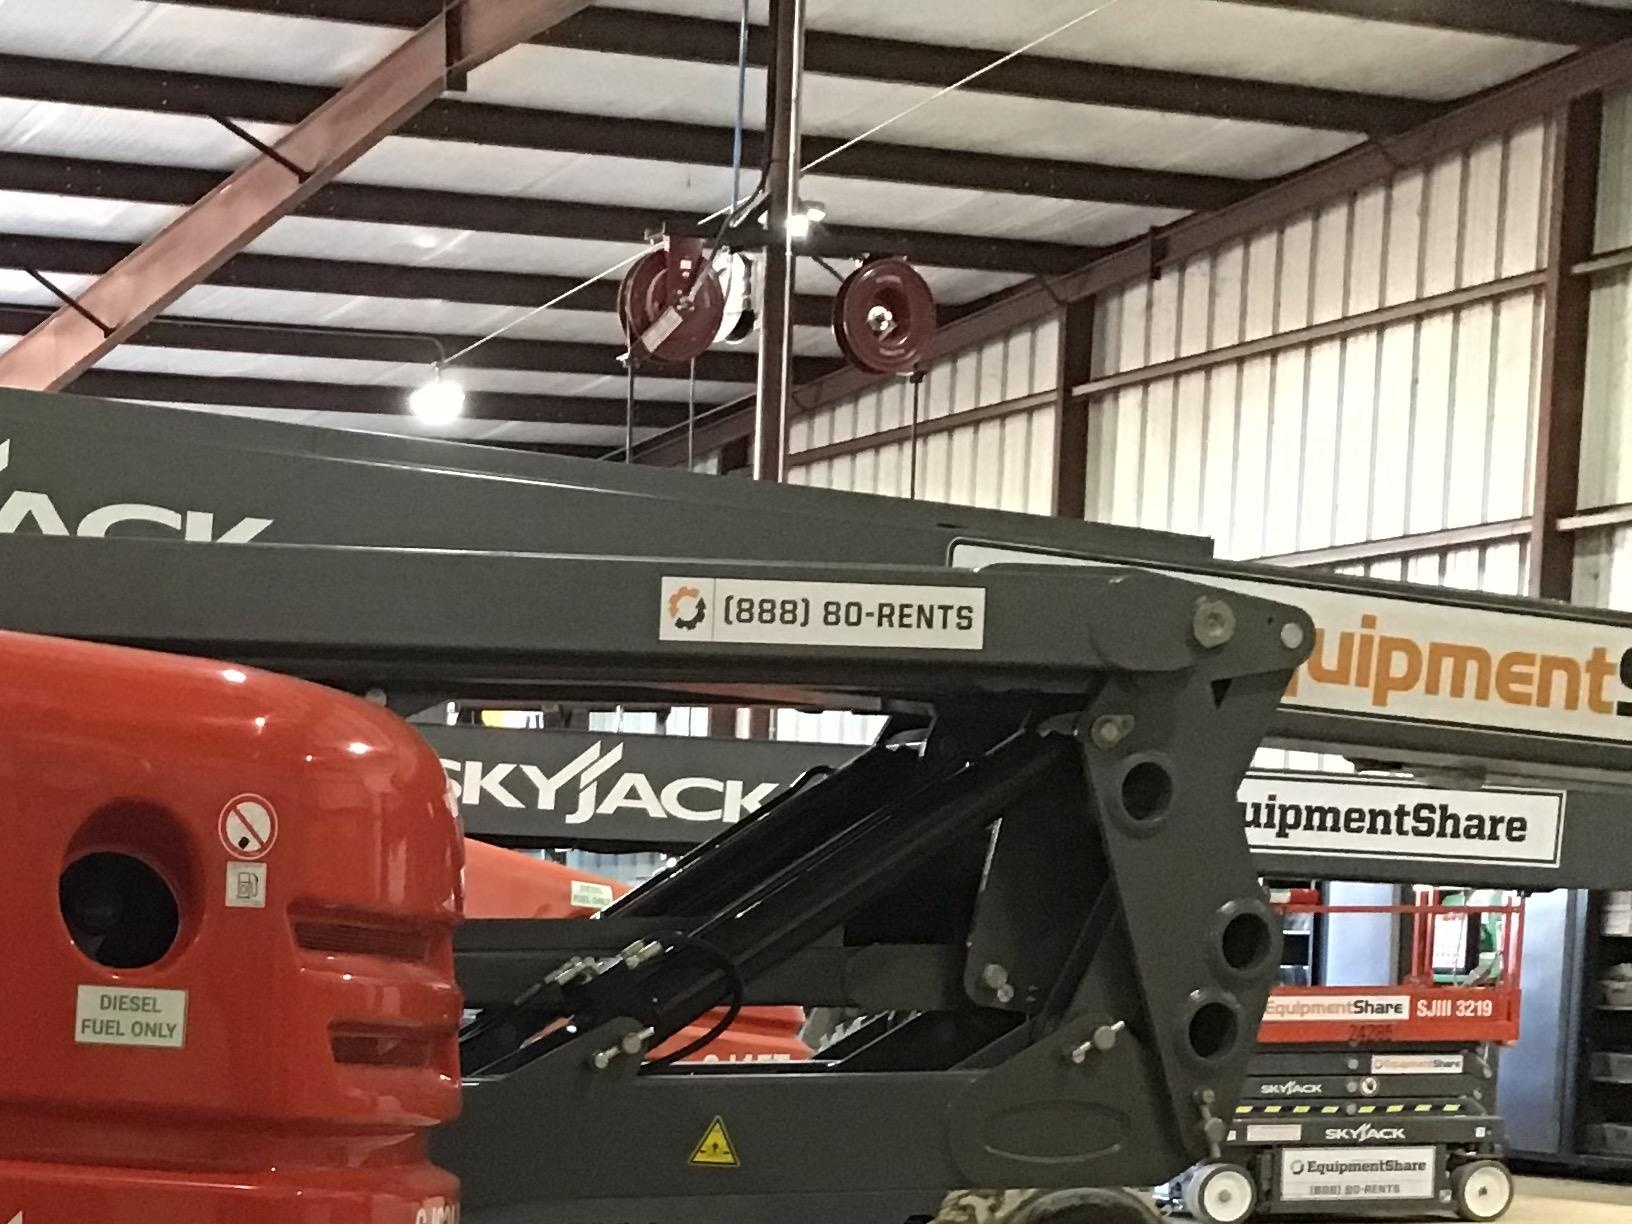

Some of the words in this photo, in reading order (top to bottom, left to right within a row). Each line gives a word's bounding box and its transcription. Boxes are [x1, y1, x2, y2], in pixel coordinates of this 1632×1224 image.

[724, 595, 810, 627] (888)
[822, 600, 974, 631] 80-RENTS
[1285, 613, 1632, 717] uipment
[99, 993, 163, 1014] DIESEL
[1455, 999, 1493, 1017] 3219
[80, 1018, 126, 1038] FUEL
[130, 1020, 178, 1040] ONLY
[1260, 1080, 1322, 1095] SKYJACK
[1325, 1123, 1406, 1141] SKYJACK
[1307, 1159, 1427, 1175] EquipmentShare
